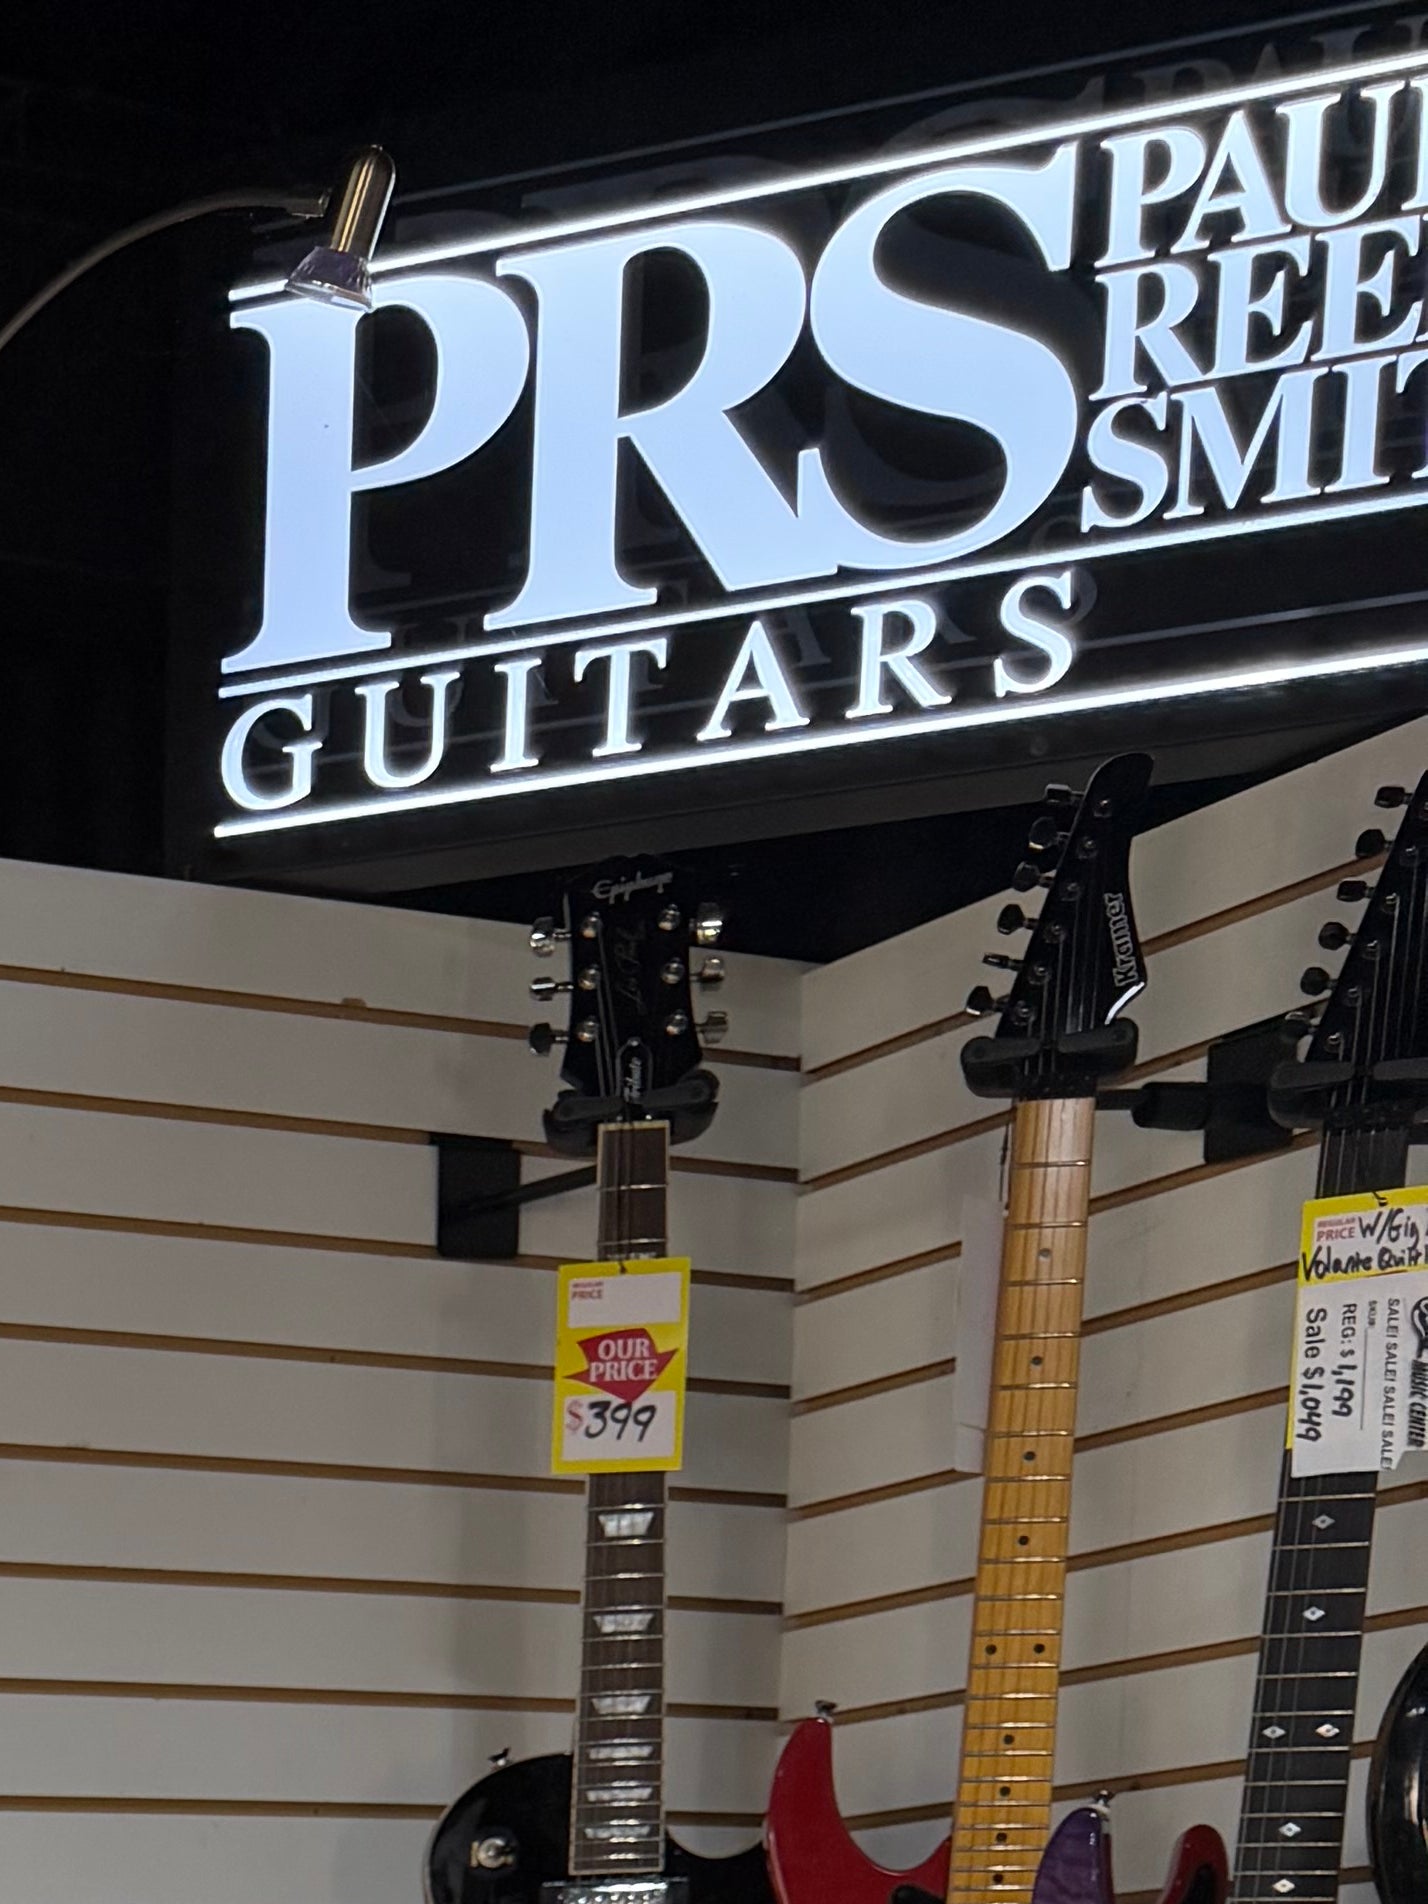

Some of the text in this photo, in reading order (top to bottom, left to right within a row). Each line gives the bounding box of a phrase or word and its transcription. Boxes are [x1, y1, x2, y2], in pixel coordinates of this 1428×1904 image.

[1089, 213, 1428, 401] REE
[221, 143, 1079, 673] PRS
[1081, 349, 1428, 533] SMI
[221, 569, 1079, 810] GUITARS
[591, 870, 673, 905] Epiphone
[1104, 892, 1142, 987] Kramer
[1316, 1227, 1355, 1242] PRICE
[1304, 1308, 1328, 1359] Sale
[1340, 1303, 1357, 1344] REG:
[589, 1359, 658, 1382] PRICE
[597, 1338, 651, 1361] OUR
[565, 1400, 657, 1443] $399
[1407, 1402, 1427, 1447] CENTER
